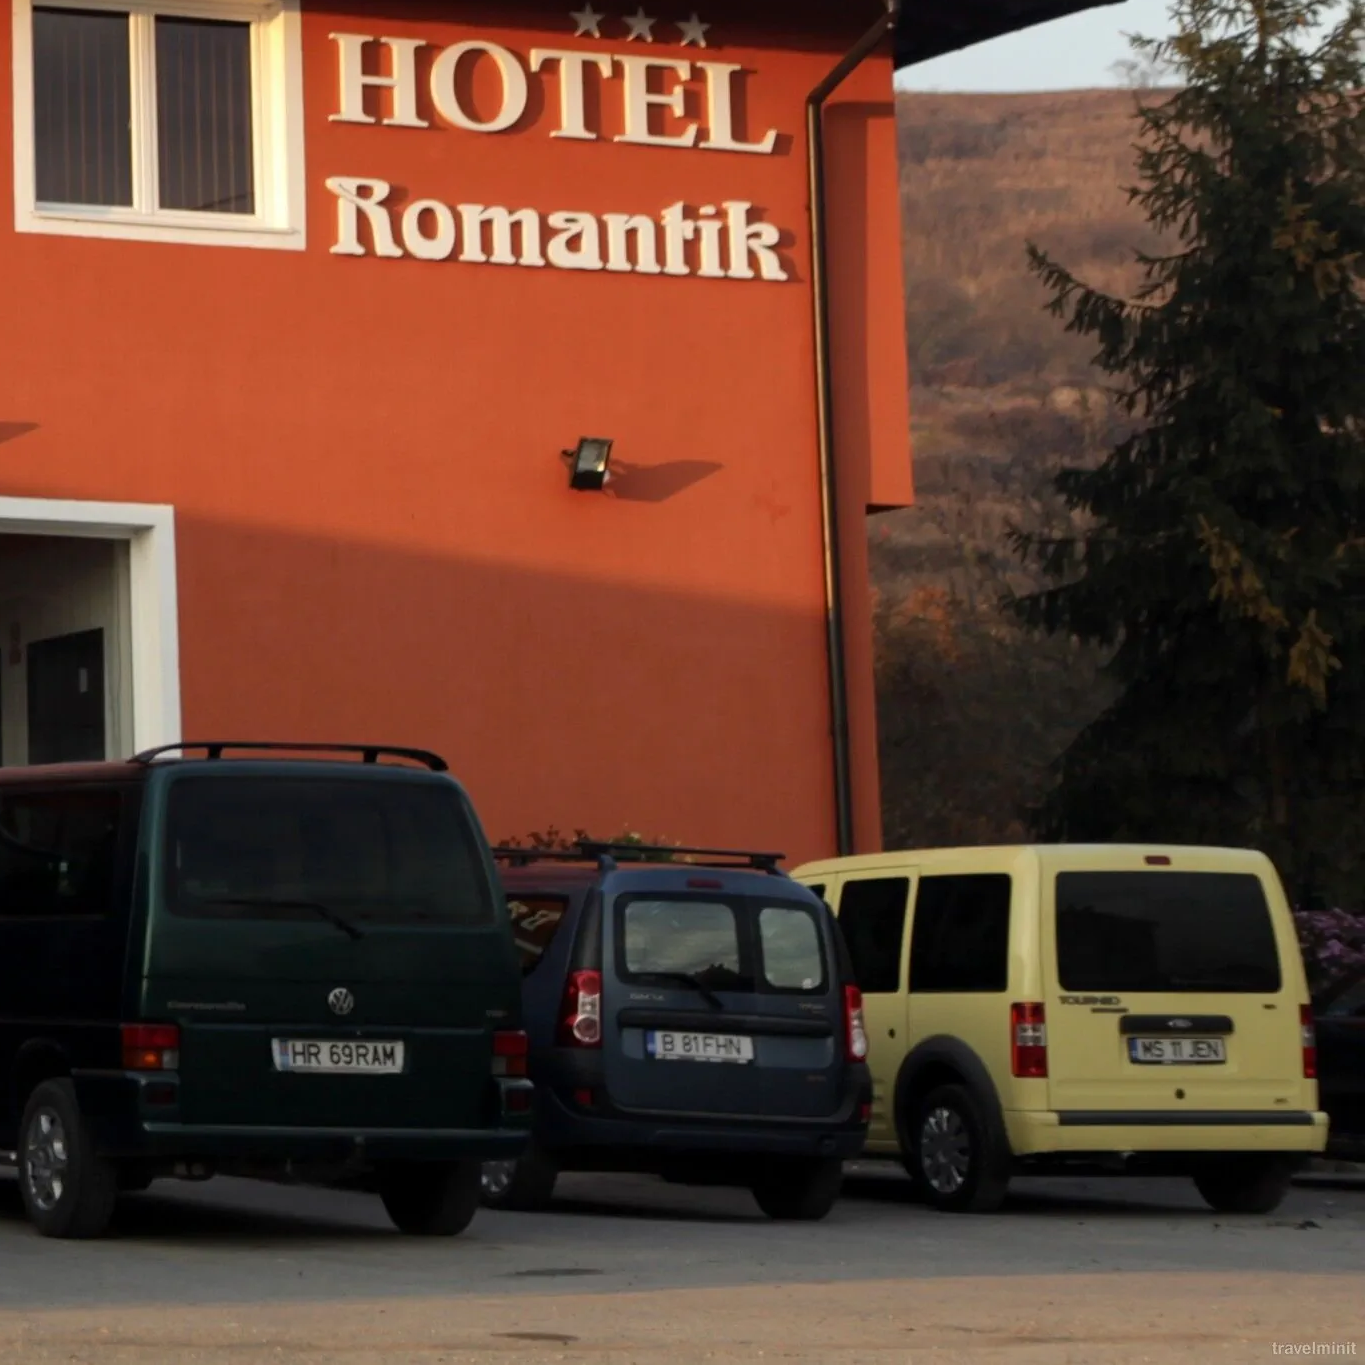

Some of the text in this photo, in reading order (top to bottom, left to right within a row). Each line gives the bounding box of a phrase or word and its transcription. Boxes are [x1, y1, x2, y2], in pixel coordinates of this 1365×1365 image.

[327, 32, 778, 154] HOTEL
[325, 176, 790, 282] Romantik
[292, 1042, 322, 1065] HR
[661, 1033, 674, 1052] B
[1141, 1040, 1165, 1058] MS
[1188, 1041, 1219, 1058] JEN
